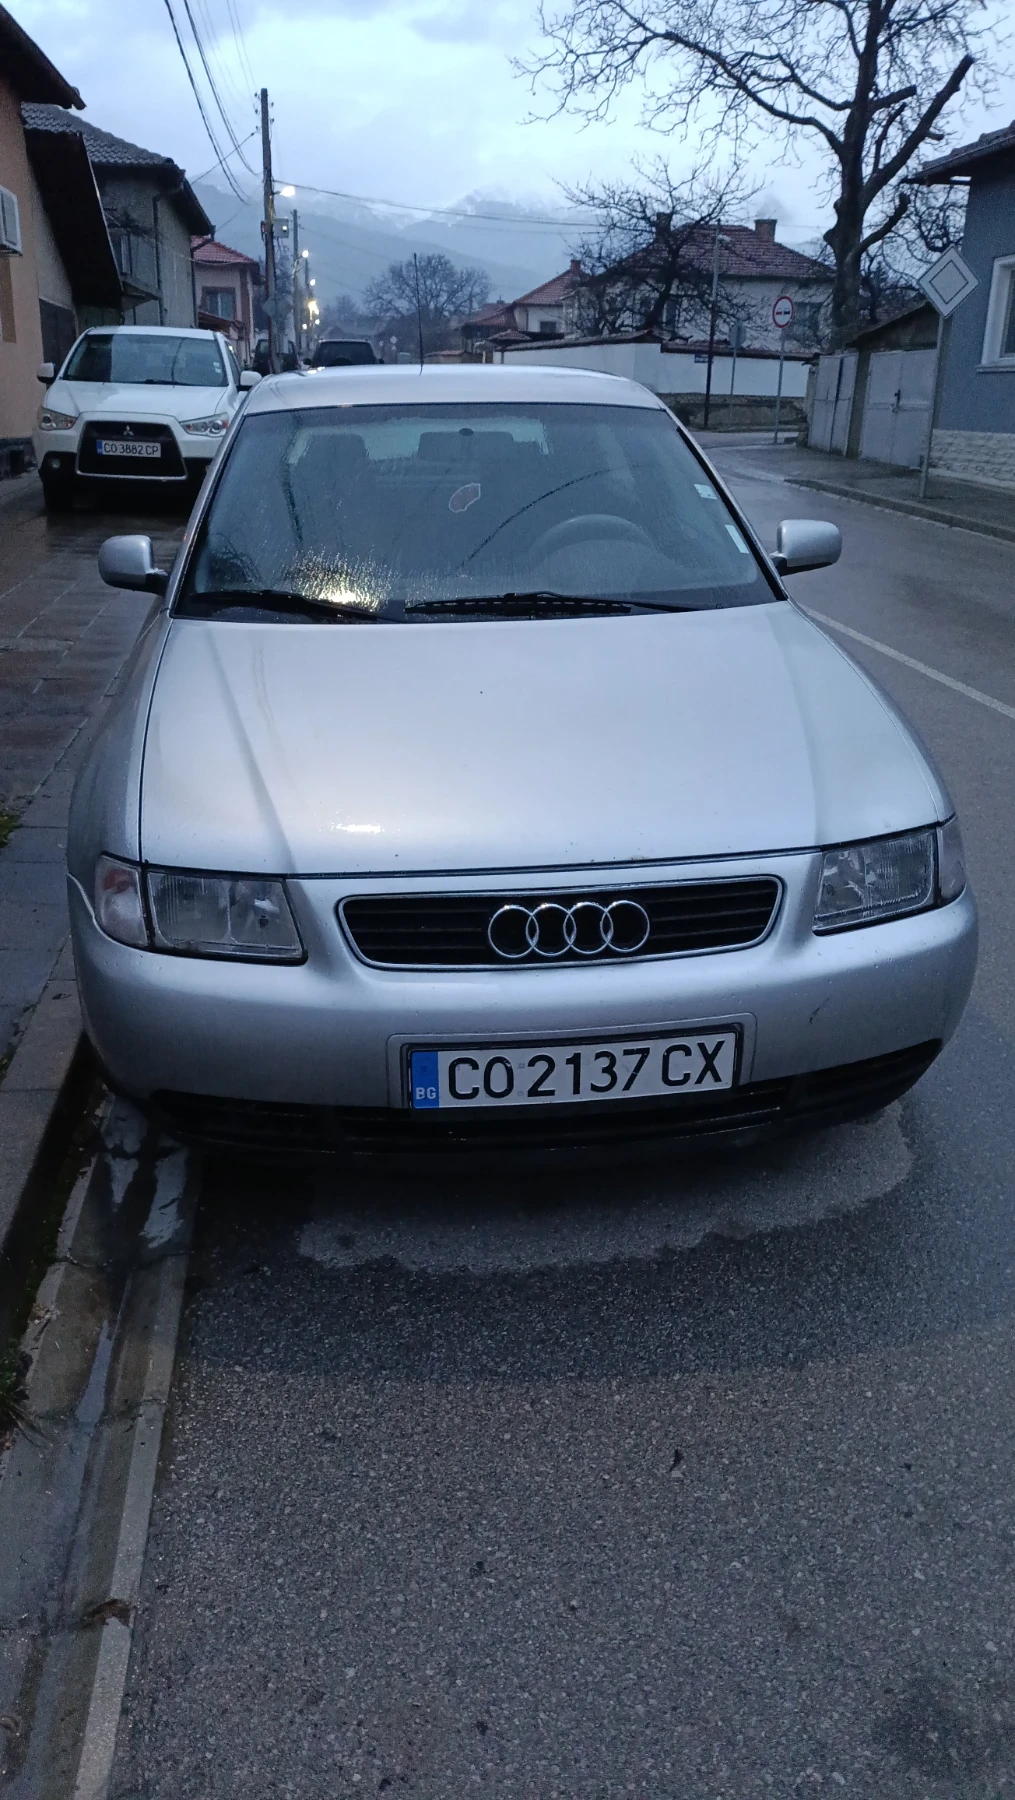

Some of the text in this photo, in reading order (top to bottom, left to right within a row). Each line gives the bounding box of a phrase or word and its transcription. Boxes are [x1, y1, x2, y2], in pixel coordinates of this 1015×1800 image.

[119, 443, 144, 455] 3882
[448, 1040, 726, 1100] CO 2137 CX
[415, 1086, 437, 1100] BG
